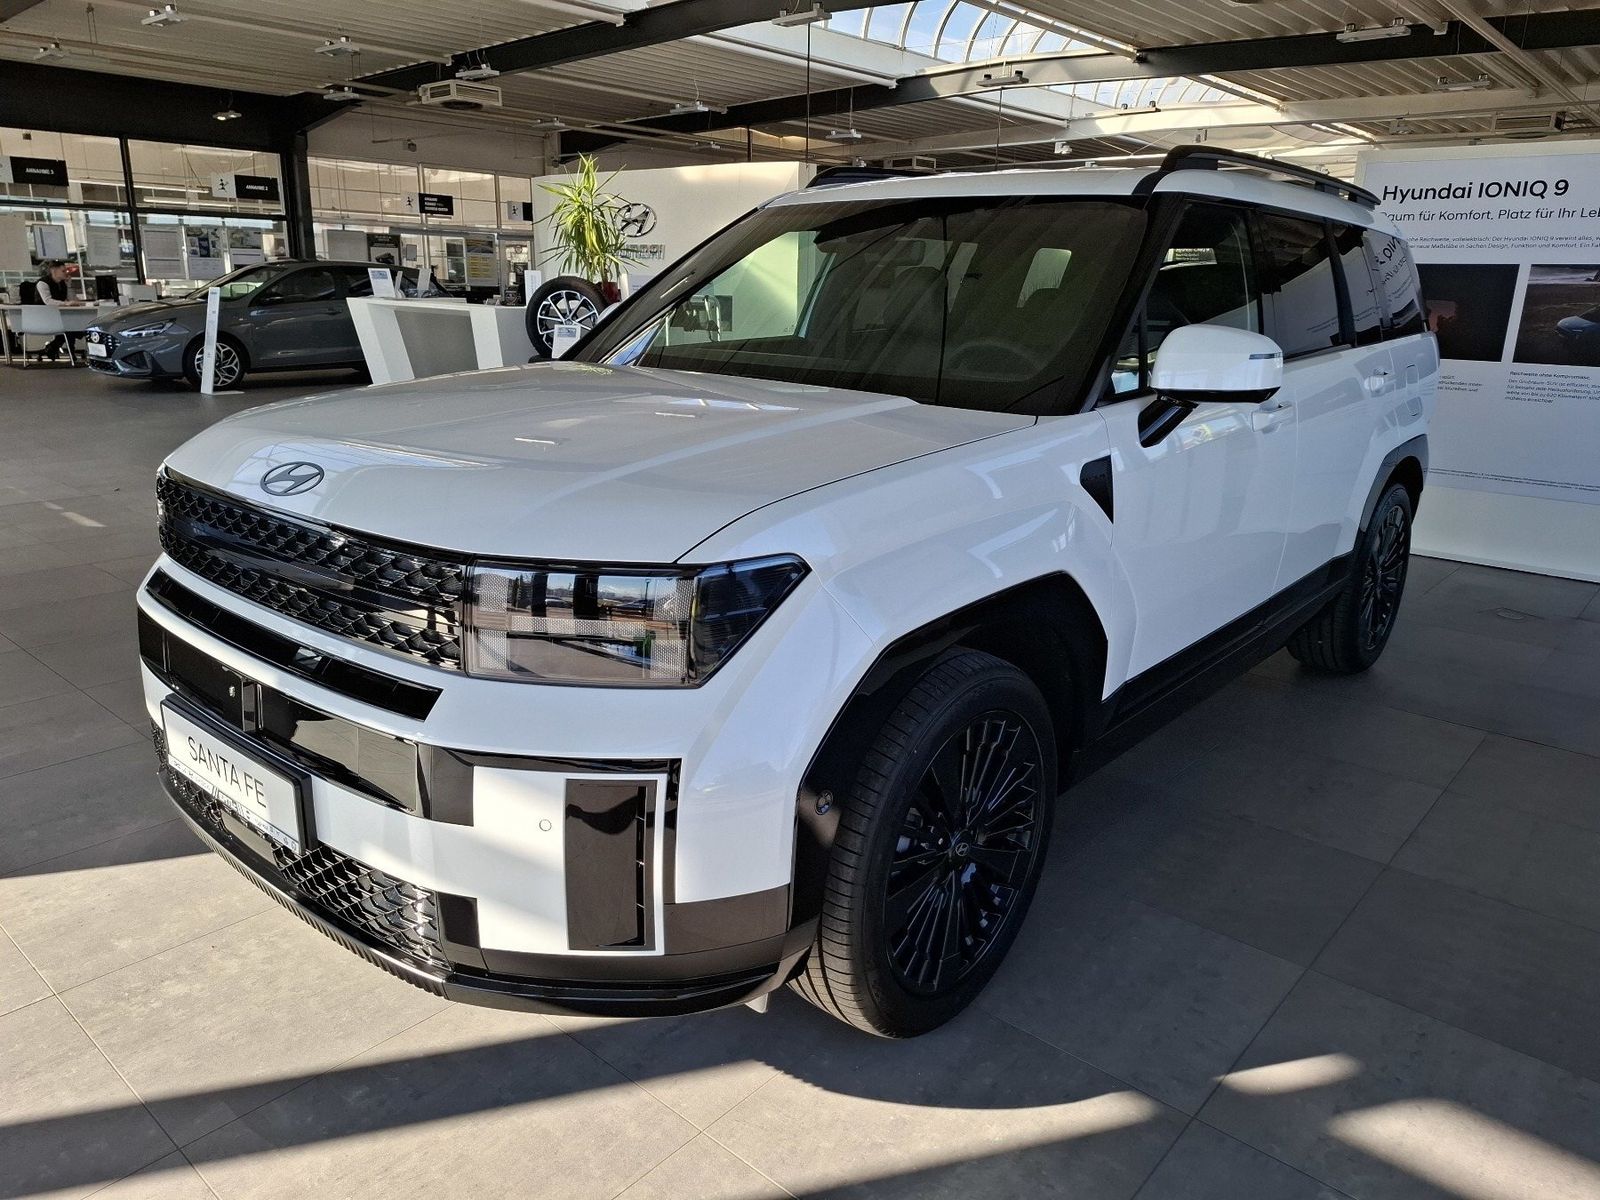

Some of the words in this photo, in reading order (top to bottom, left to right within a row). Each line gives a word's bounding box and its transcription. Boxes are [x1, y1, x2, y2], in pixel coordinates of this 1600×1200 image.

[1382, 182, 1473, 204] Hyundai
[1478, 180, 1546, 200] IONIQ
[1553, 179, 1569, 196] 9
[1419, 210, 1436, 221] für
[1498, 208, 1532, 220] Platz
[1535, 207, 1555, 219] für
[1558, 207, 1577, 219] Ihr
[187, 735, 242, 792] SANTA
[244, 771, 267, 809] FE
